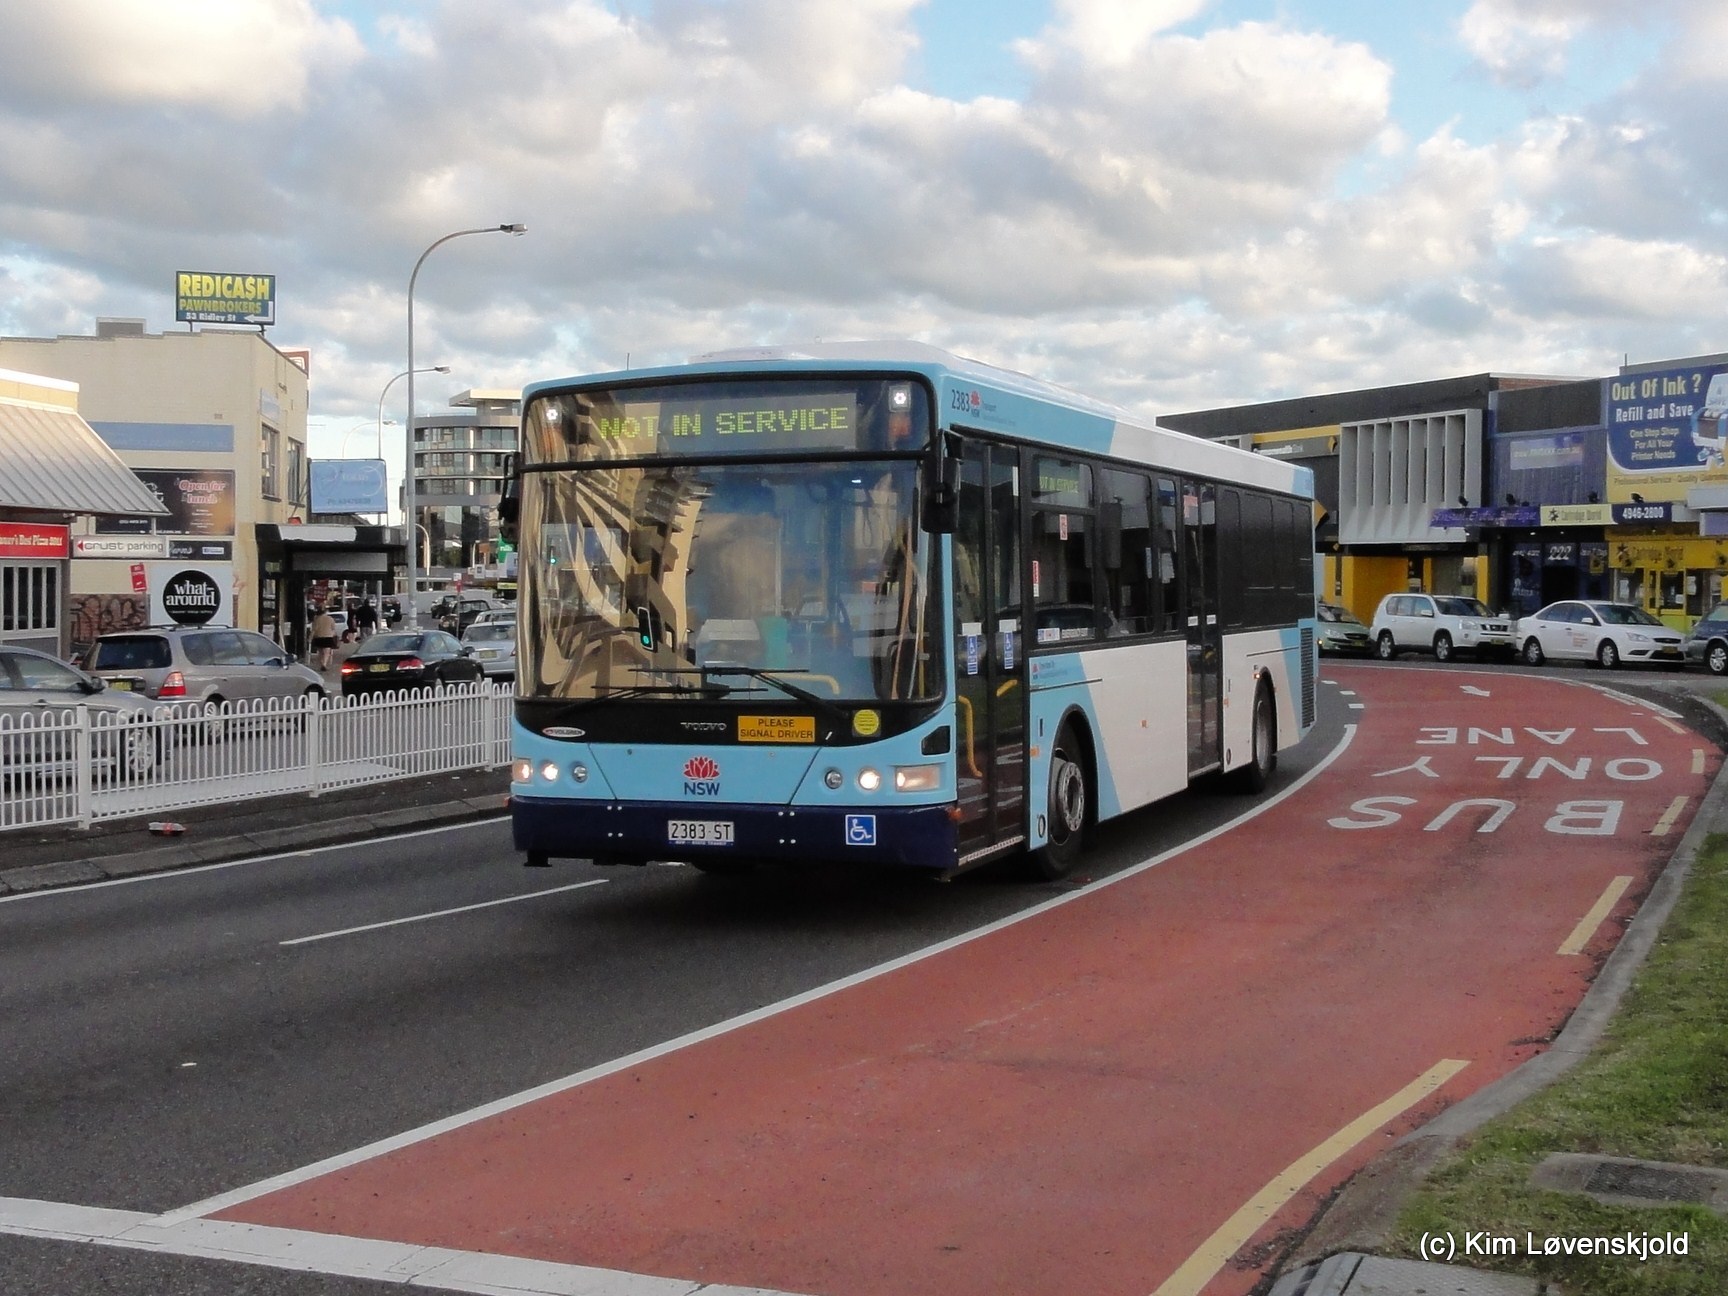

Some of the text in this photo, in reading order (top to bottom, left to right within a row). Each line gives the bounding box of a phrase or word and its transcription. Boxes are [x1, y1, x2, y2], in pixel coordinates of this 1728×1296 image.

[180, 299, 261, 313] PAWNBROKERS
[1612, 382, 1636, 401] Out
[1642, 378, 1658, 398] Of
[1663, 375, 1686, 396] Ink
[951, 389, 969, 412] 2383
[1616, 402, 1694, 422] Refill and Save
[600, 407, 848, 439] NOT IN SERVICE
[1661, 426, 1680, 437] Shop
[1658, 439, 1674, 448] Your
[84, 542, 124, 550] crust
[127, 541, 164, 553] parking
[1549, 546, 1572, 560] 222
[166, 591, 217, 606] around
[680, 722, 727, 731] VOLVO
[758, 718, 795, 728] PLEASE
[740, 729, 813, 739] SIGNAL DRIVER
[1416, 727, 1649, 745] LANE
[1371, 756, 1663, 780] ONLY
[684, 782, 720, 796] NSW
[1327, 796, 1624, 835] BUS
